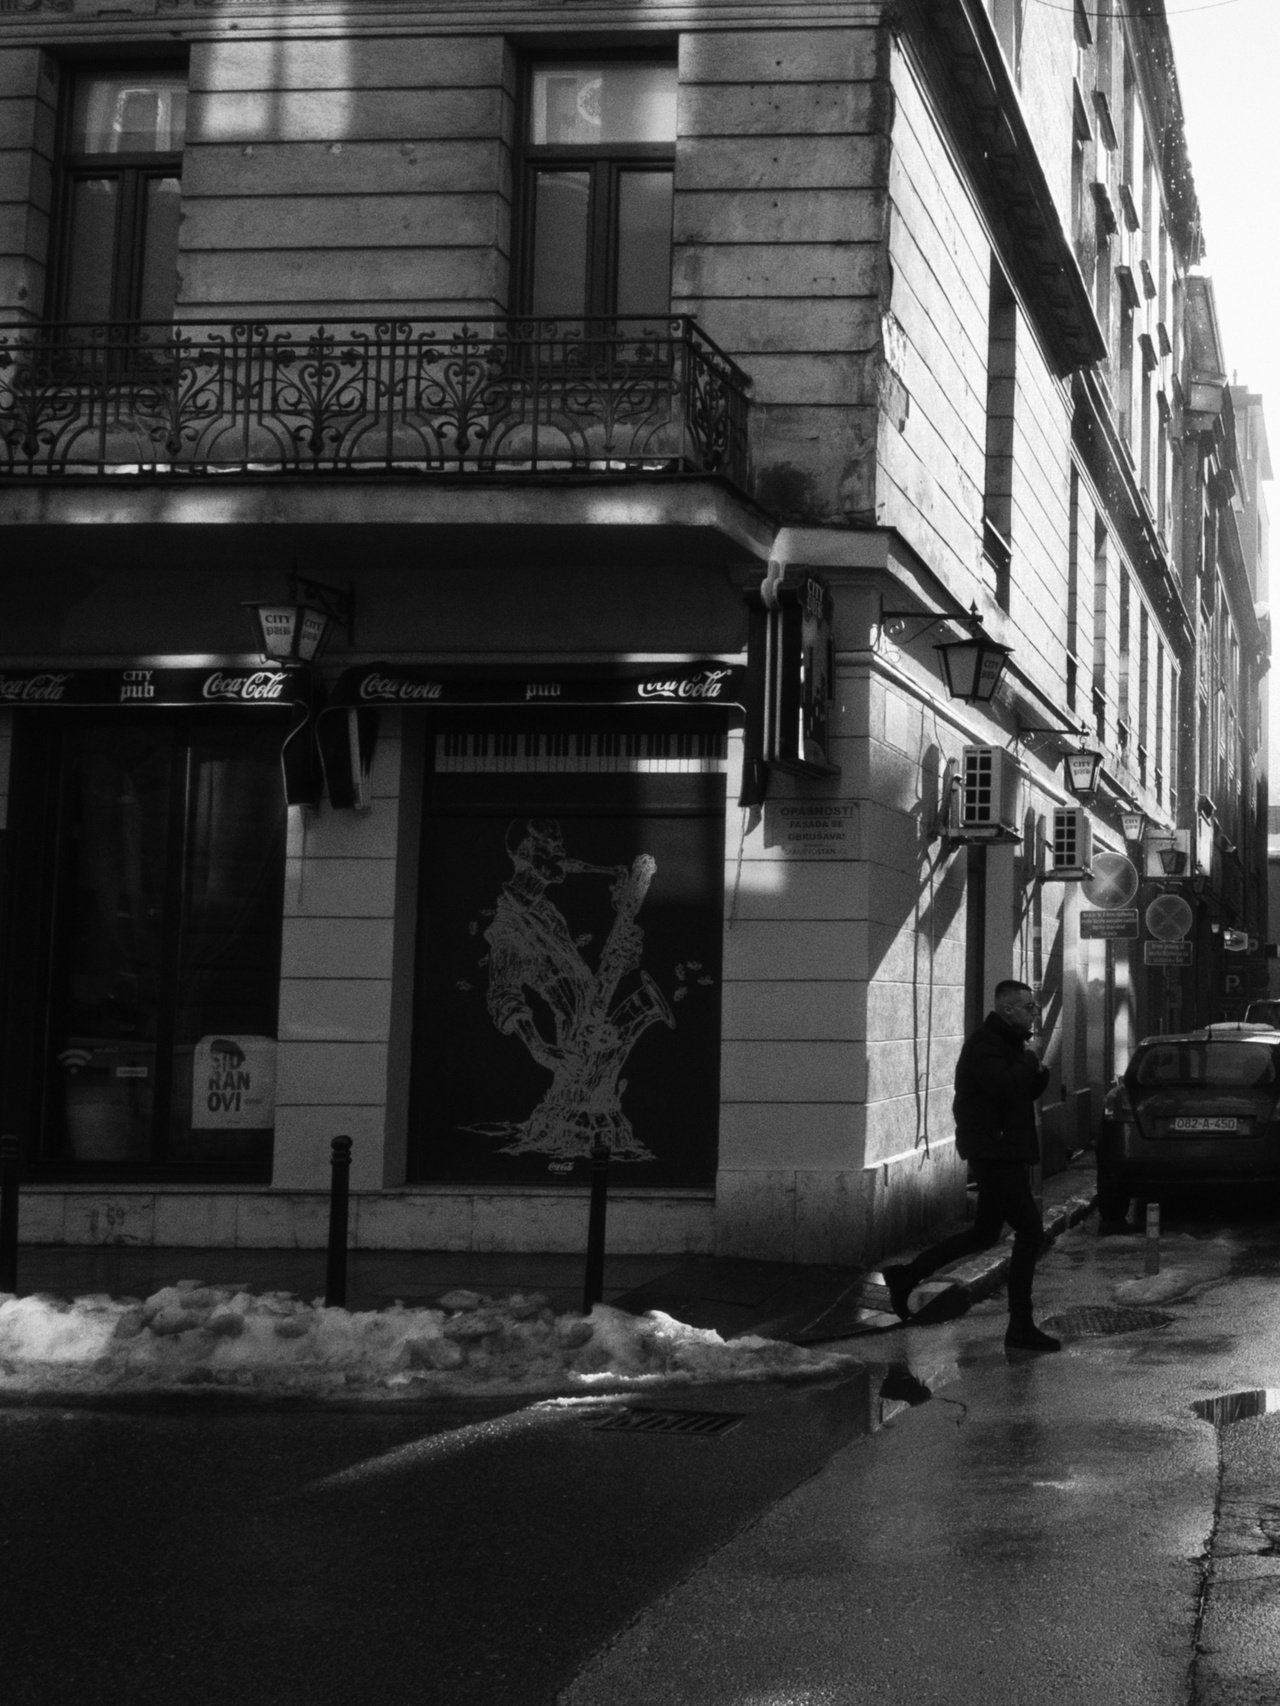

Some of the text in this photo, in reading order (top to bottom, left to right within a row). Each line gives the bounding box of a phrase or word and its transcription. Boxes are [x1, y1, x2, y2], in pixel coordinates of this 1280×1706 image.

[806, 577, 825, 603] CITY
[264, 614, 292, 624] CITY
[304, 618, 322, 631] CITY
[983, 659, 999, 670] CITY
[122, 670, 153, 681] CITY
[202, 671, 290, 699] Coca-Cola
[119, 683, 155, 703] pub
[780, 806, 854, 817] OPASNOST!
[789, 820, 844, 828] FASADA SE
[207, 1091, 242, 1112] OVI
